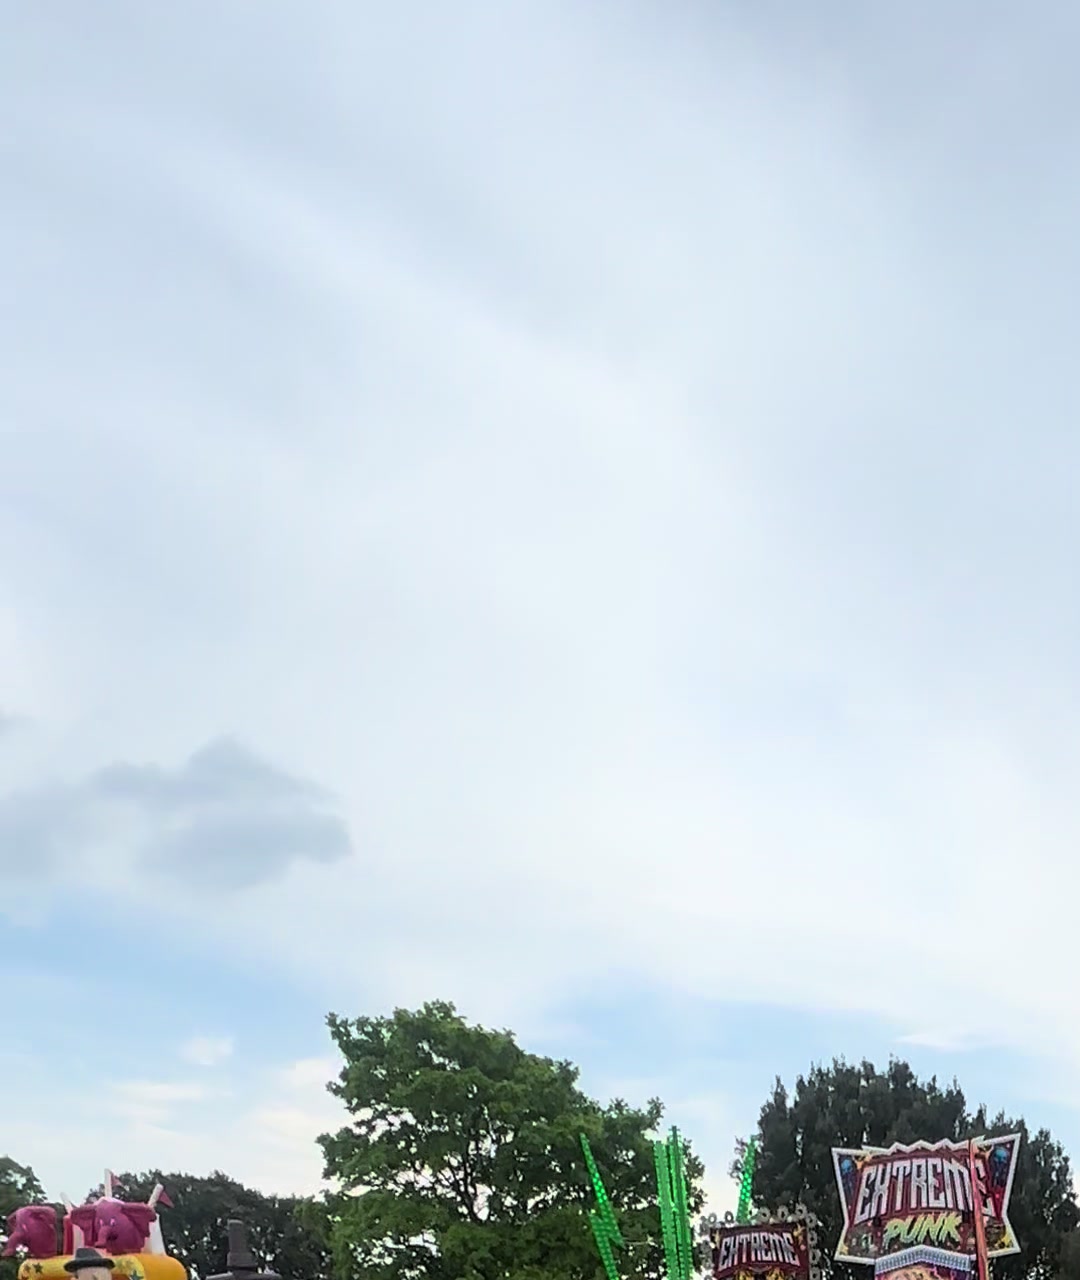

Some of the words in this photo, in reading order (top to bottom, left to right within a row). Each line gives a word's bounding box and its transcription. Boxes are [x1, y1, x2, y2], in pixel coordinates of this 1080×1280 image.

[853, 1157, 996, 1226] EXTREME
[883, 1212, 964, 1249] PUNK
[717, 1231, 801, 1270] EXTREME
